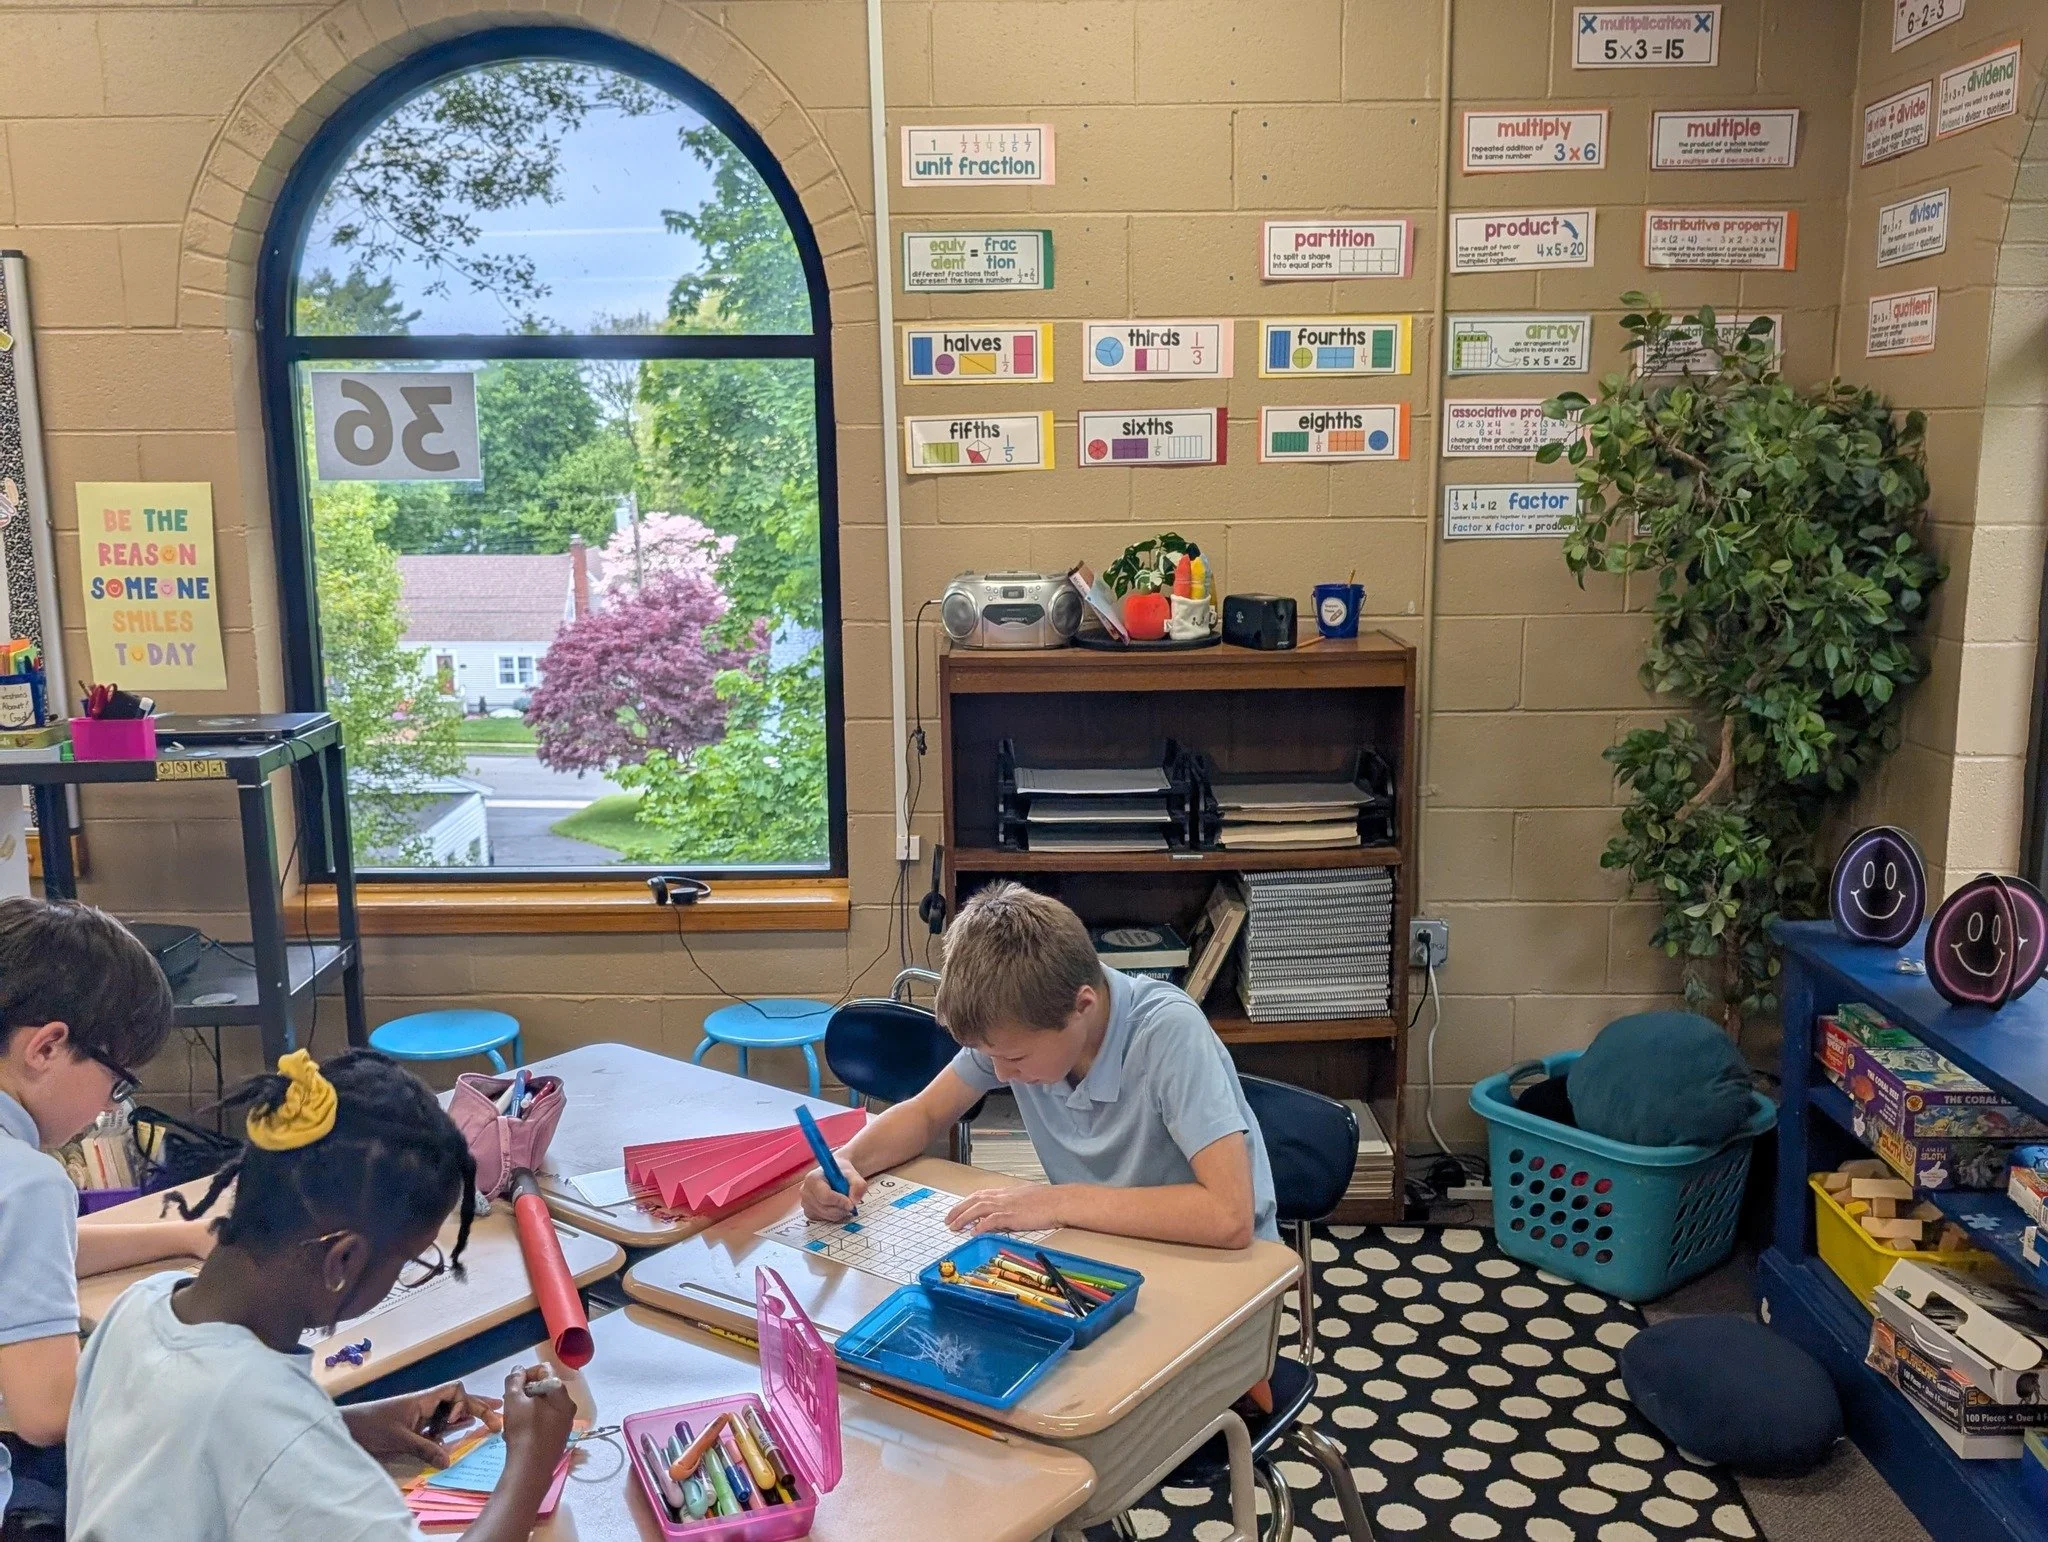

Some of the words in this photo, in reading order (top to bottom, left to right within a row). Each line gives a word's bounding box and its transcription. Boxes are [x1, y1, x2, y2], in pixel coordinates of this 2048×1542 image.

[1600, 15, 1691, 34] multiplication
[1967, 56, 2014, 92] dividend
[1896, 98, 1926, 124] divide
[1498, 118, 1572, 140] multiply
[1687, 118, 1761, 140] multiple
[1554, 143, 1566, 161] 3
[1584, 143, 1596, 160] 6
[916, 157, 952, 175] unit
[959, 156, 1035, 175] fraction
[1909, 201, 1943, 225] divisor
[1485, 217, 1559, 242] product
[1653, 219, 1720, 231] distributive
[1723, 218, 1779, 234] property
[930, 238, 966, 255] equiv
[985, 237, 1017, 251] frac
[1295, 229, 1375, 251] partition
[1570, 242, 1584, 256] 20
[931, 256, 966, 270] alent
[986, 255, 1016, 269] tion
[1284, 253, 1298, 261] split
[1289, 261, 1309, 269] equal
[1311, 261, 1332, 269] parts
[984, 269, 998, 277] that
[1893, 295, 1931, 323] quotient
[1128, 328, 1180, 346] thirds
[1298, 328, 1366, 346] fourths
[1526, 324, 1580, 343] array
[944, 334, 1002, 352] halves
[1563, 356, 1576, 366] 25
[1452, 407, 1517, 418] associative
[950, 421, 1000, 439] fifths
[1122, 418, 1173, 436] sixths
[1299, 412, 1362, 433] eighths
[1509, 492, 1569, 510] factor
[103, 509, 132, 532] BE
[144, 508, 188, 532] THE
[1453, 523, 1482, 532] factor
[1495, 522, 1525, 531] factor
[98, 542, 196, 566] REASON
[91, 577, 210, 600] SOMEONE
[112, 610, 194, 633] SMILES
[115, 643, 196, 666] TODAY
[1, 692, 28, 700] uestions
[1945, 1095, 1962, 1104] THE
[1965, 1095, 1998, 1104] CORAL
[1966, 1414, 1980, 1422] 100
[1982, 1414, 2006, 1422] Pieces
